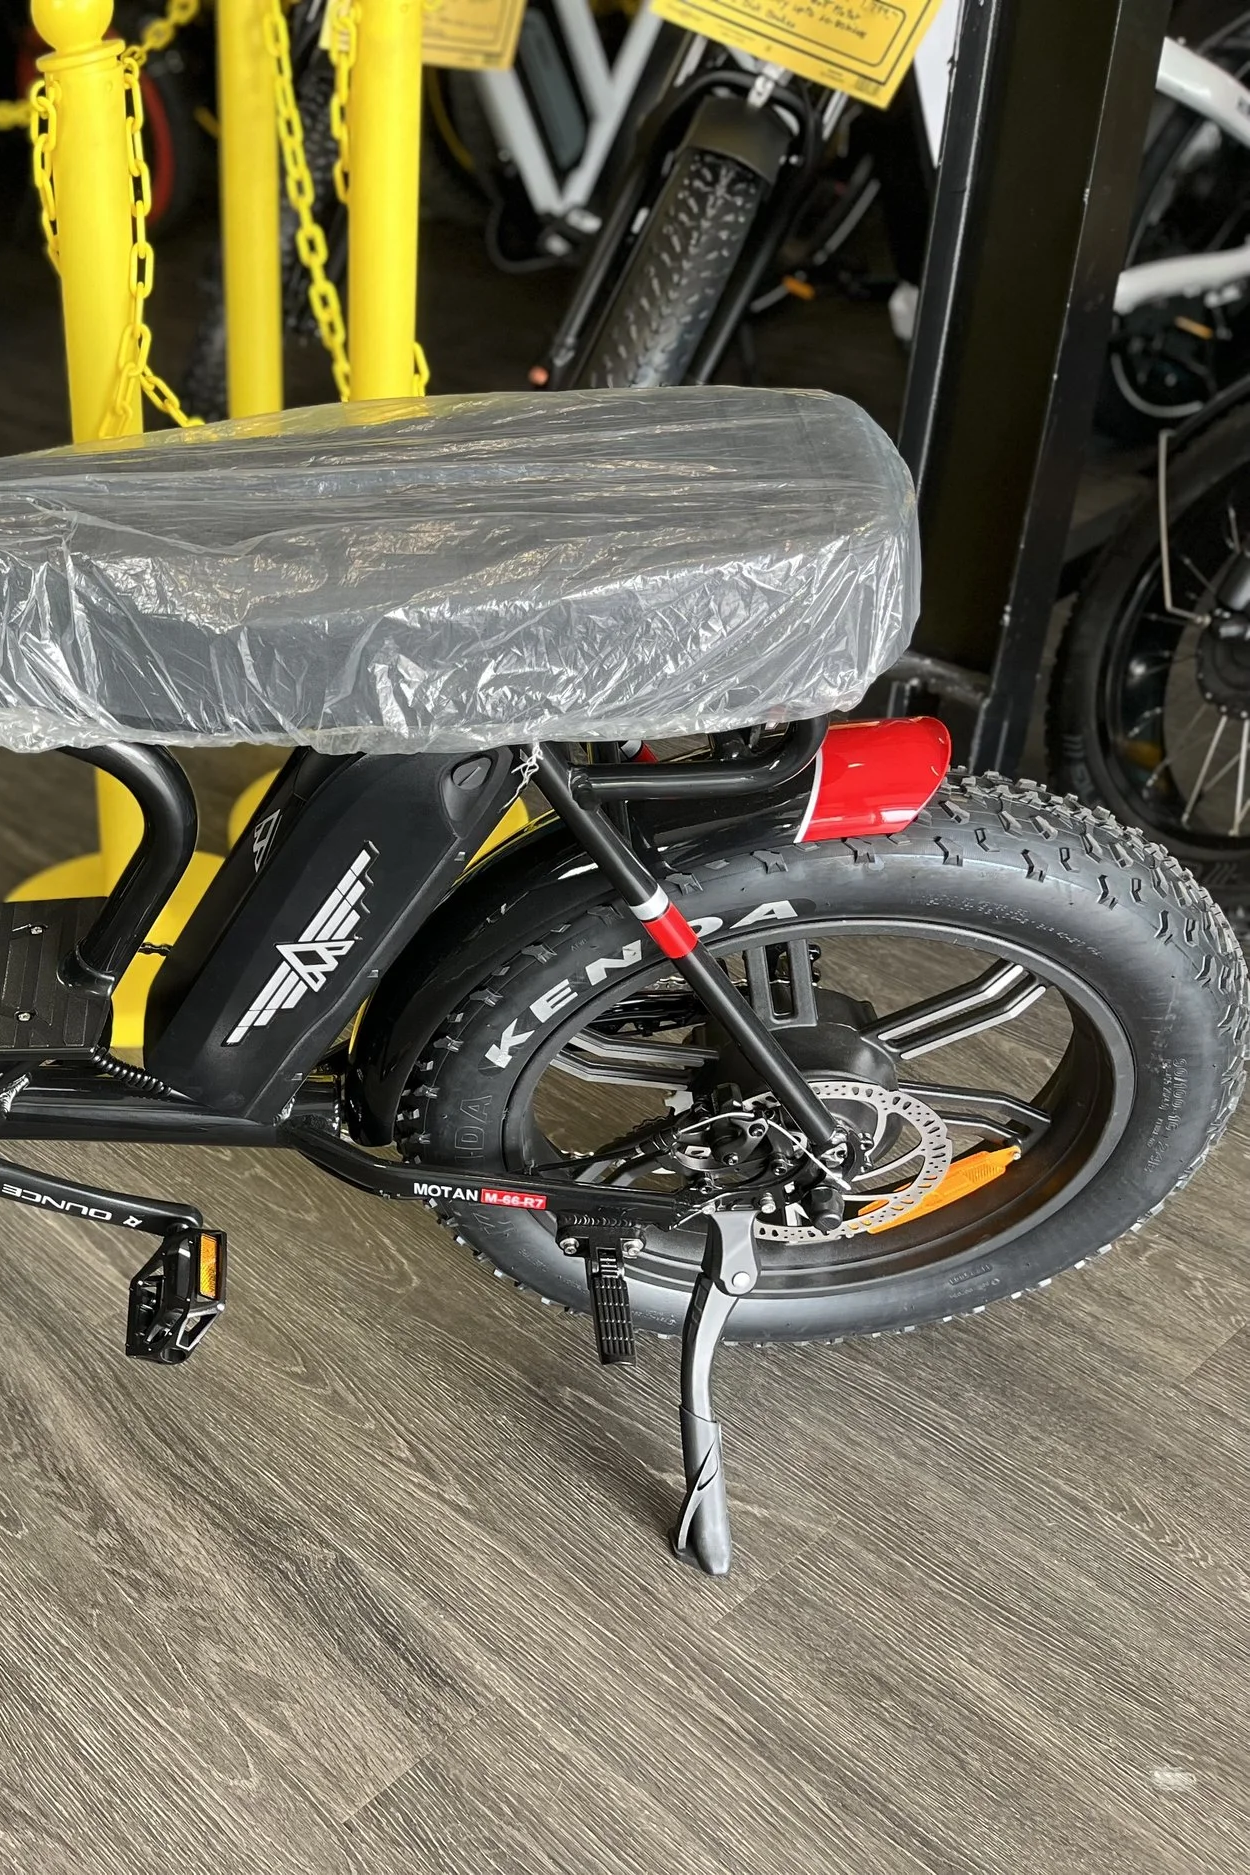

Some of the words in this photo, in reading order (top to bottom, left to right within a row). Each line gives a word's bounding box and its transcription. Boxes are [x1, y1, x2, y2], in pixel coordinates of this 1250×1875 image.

[1, 1183, 112, 1220] OUNCE
[413, 1182, 479, 1202] MOTAN
[484, 1192, 544, 1209] M-66-R7
